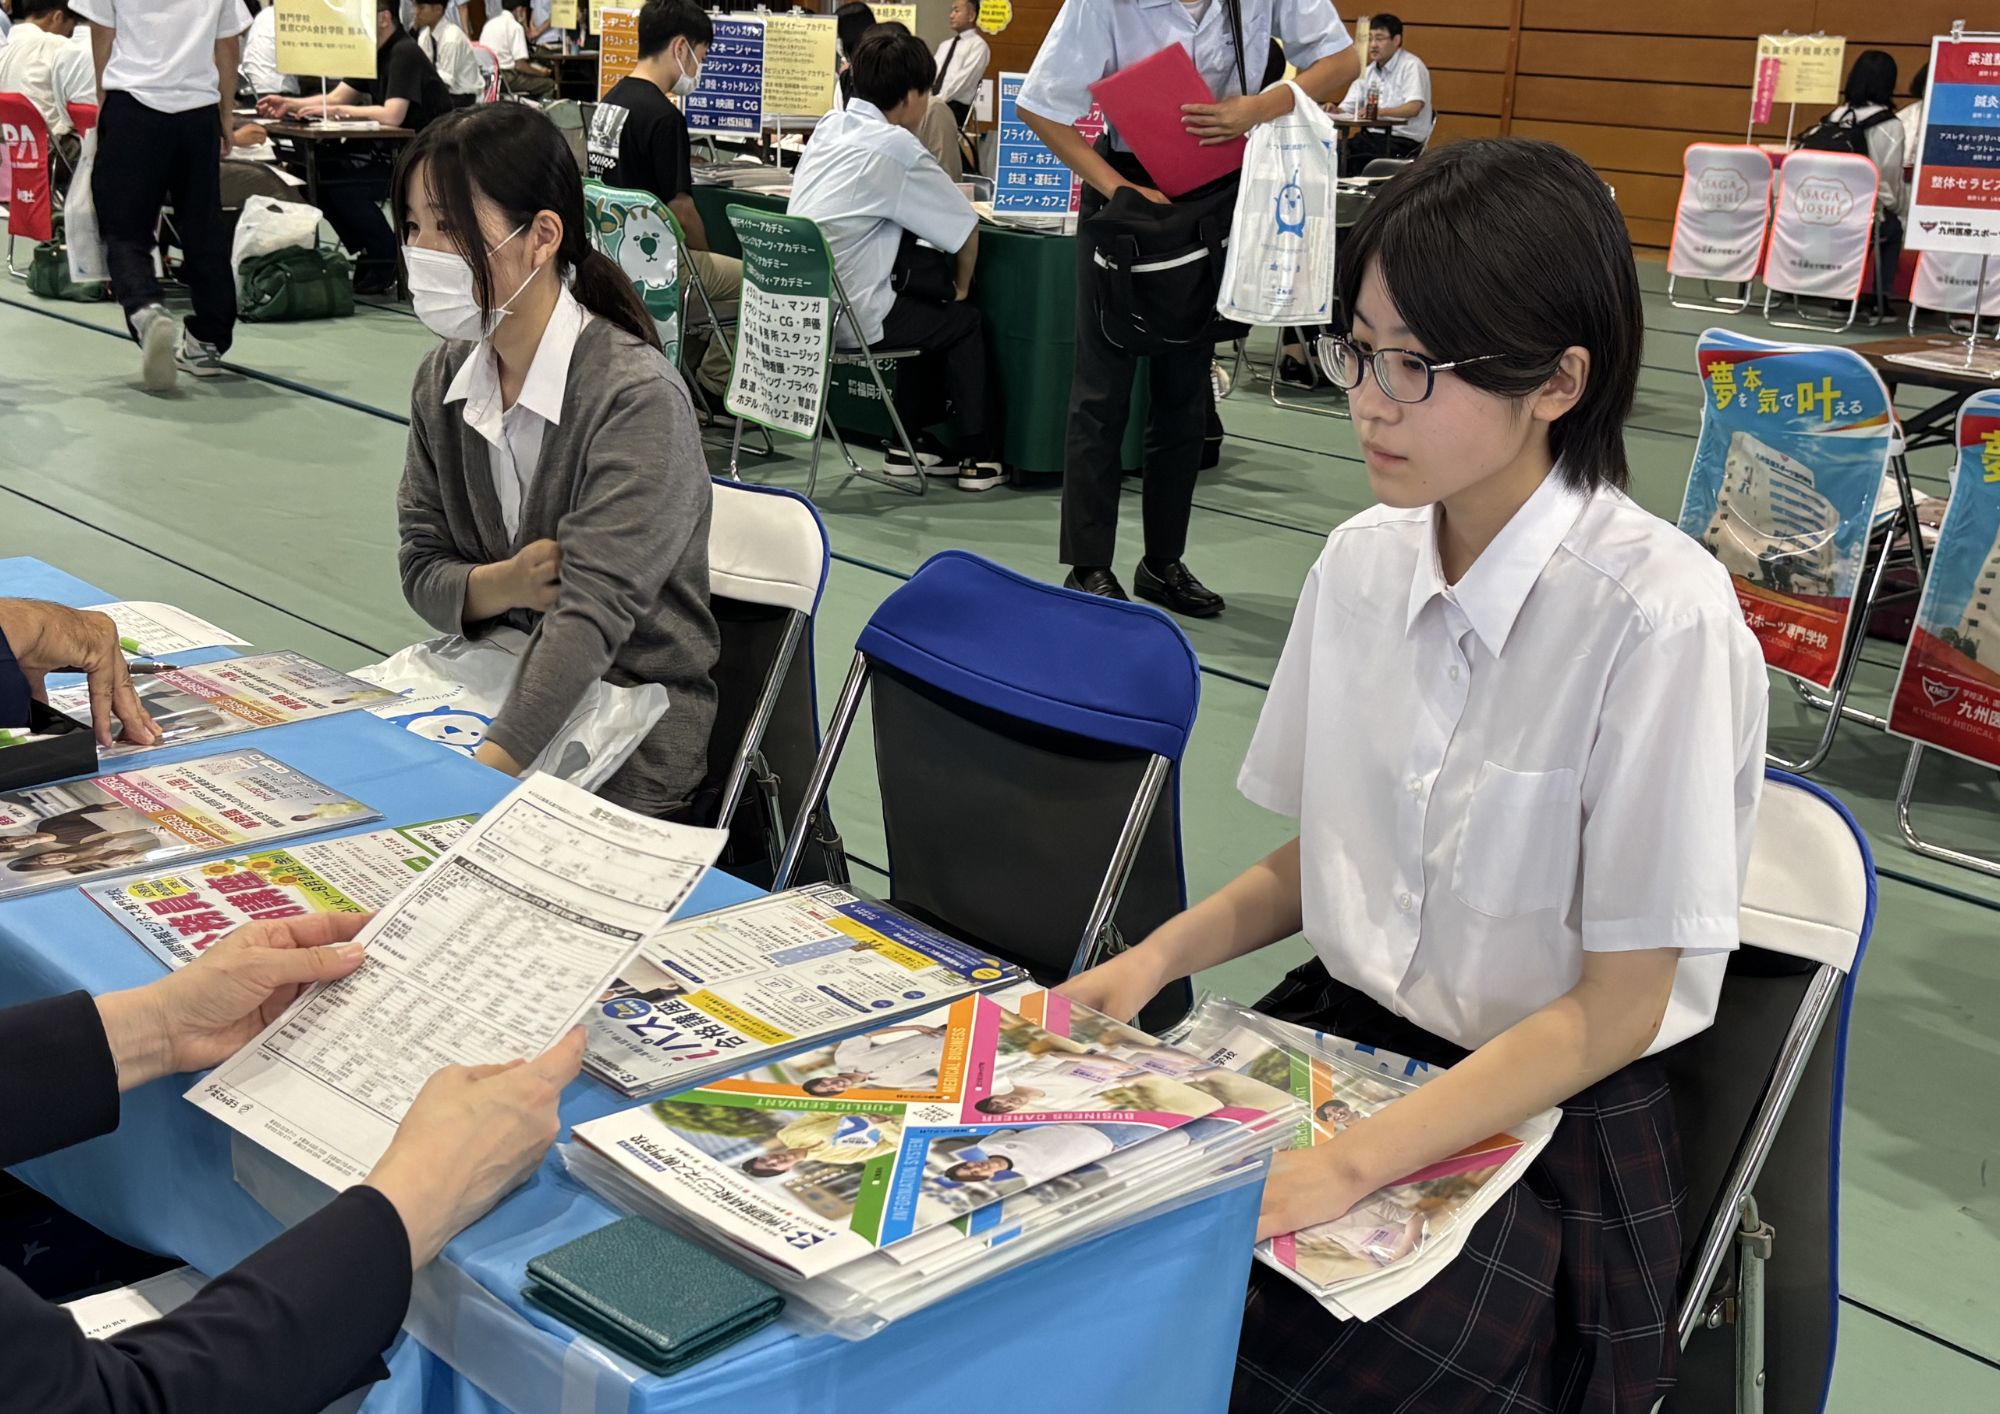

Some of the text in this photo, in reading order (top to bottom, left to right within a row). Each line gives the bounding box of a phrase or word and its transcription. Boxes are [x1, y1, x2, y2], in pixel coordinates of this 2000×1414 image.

[997, 194, 1067, 207] スイーツ・カフェ
[1708, 361, 1863, 422] 夢を本気で叶える
[1742, 608, 1829, 650] スポーツ専門学校
[1912, 706, 1994, 740] KYUSHU MEDICAL
[652, 998, 747, 1051] 合格講座
[942, 1026, 967, 1093] MEDICAL BUSINESS
[755, 1097, 894, 1112] PUBLIC SERVANT
[981, 1112, 1135, 1122] BUSINESS CAREER
[892, 1137, 924, 1222] INFORMATION SYSTEM
